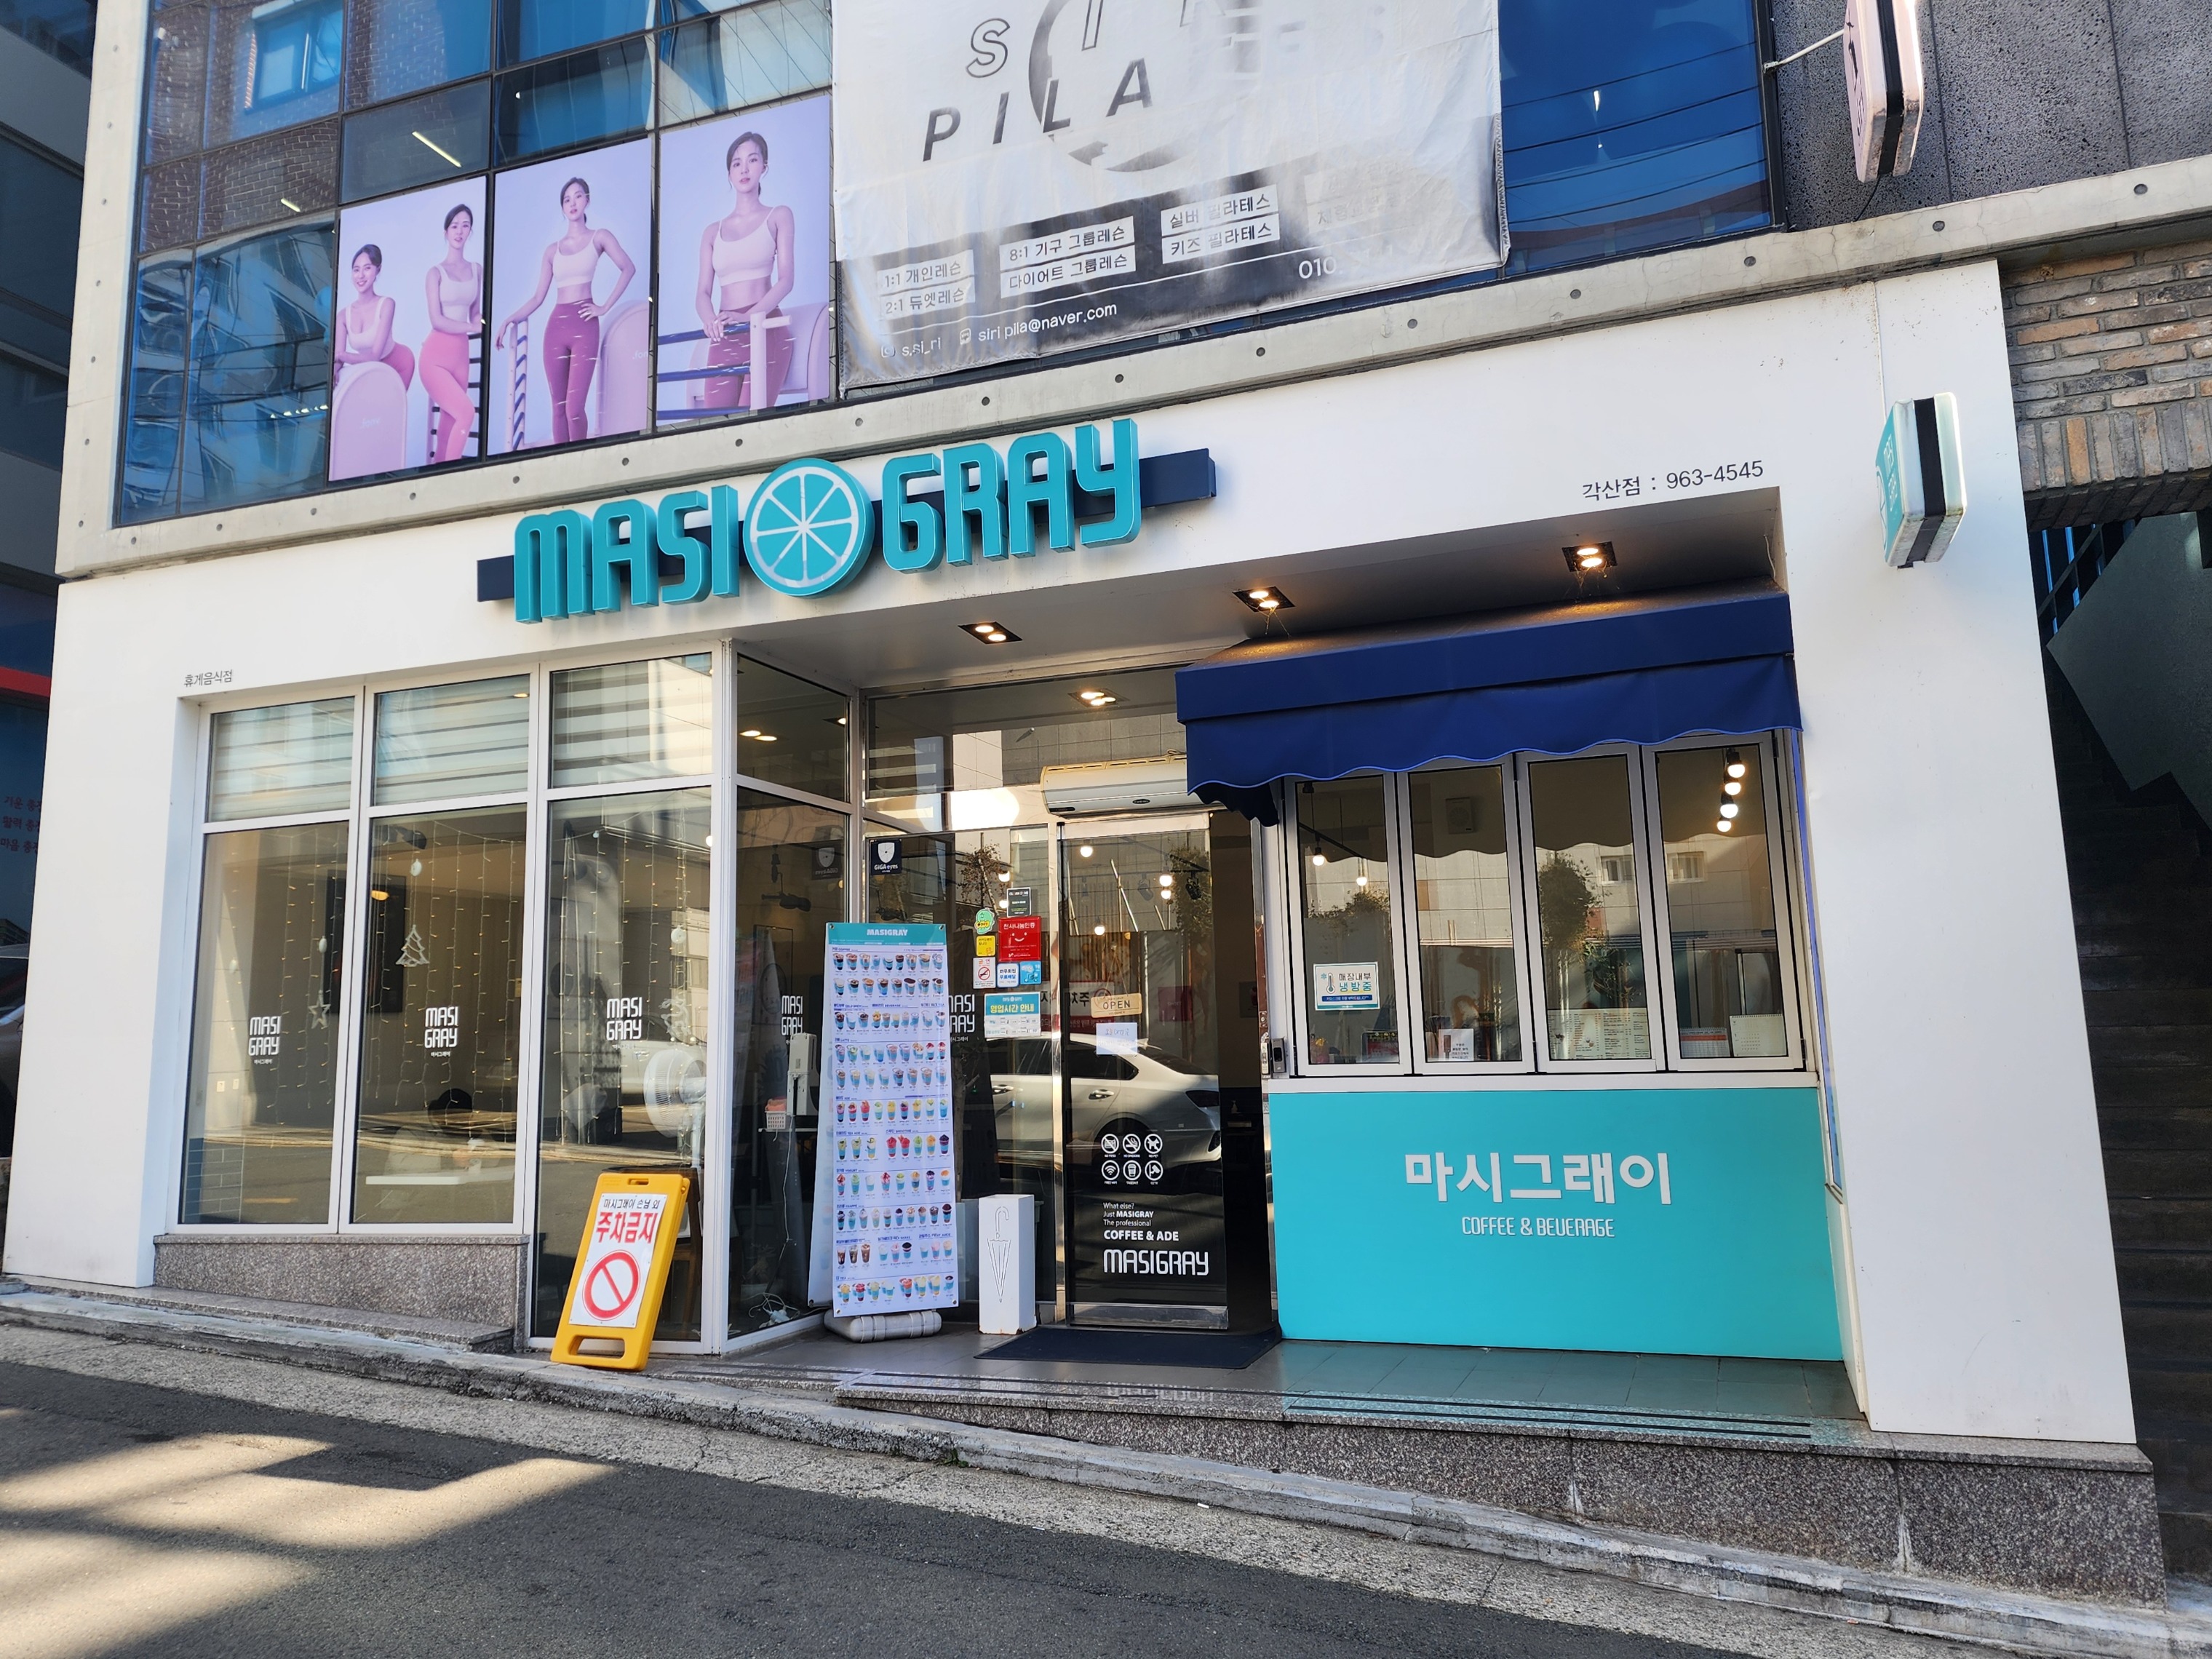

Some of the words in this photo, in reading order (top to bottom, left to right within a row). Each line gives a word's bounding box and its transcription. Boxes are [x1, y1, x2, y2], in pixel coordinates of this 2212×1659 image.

[1169, 210, 1200, 229] 실버
[1207, 193, 1271, 221] 필라테스
[1008, 246, 1030, 261] 8:1
[1035, 236, 1064, 257] 기구
[1067, 225, 1126, 251] 그룹레슨
[1170, 237, 1201, 256] 키즈
[1207, 222, 1272, 250] 필라테스
[884, 273, 902, 289] 1:1
[905, 260, 962, 283] 개인레슨
[1008, 266, 1065, 290] 다이어트
[1070, 252, 1128, 276] 그룹레슨
[885, 298, 904, 314] 2:1
[908, 286, 966, 310] 듀엣레슨
[1582, 476, 1641, 501] 각산점
[1666, 459, 1764, 490] 963-4545
[514, 485, 740, 624] MASI
[881, 416, 1140, 575] GRAY
[184, 669, 233, 688] 휴게음식점
[1338, 972, 1372, 981] 매장내부
[606, 997, 642, 1019] MASI
[781, 995, 803, 1014] MASI
[990, 1004, 1019, 1014] 영업시간
[1019, 1003, 1035, 1013] 안내
[1102, 998, 1131, 1010] OPEN
[249, 1016, 282, 1035] MASI
[425, 1006, 458, 1027] MASI
[781, 1017, 803, 1036] GRAY
[949, 1014, 975, 1033] RAY
[424, 1027, 458, 1049] GRAY
[606, 1019, 642, 1041] GRAY
[248, 1036, 280, 1057] GRAY
[1405, 1152, 1671, 1205] 마시그래이
[603, 1198, 636, 1209] 마시그래이
[637, 1199, 651, 1209] 손님
[652, 1199, 661, 1209] 외
[1102, 1210, 1115, 1218] Just
[1115, 1210, 1155, 1218] MASIGRAY
[596, 1211, 659, 1244] 주차금지
[1115, 1219, 1152, 1228] professional
[1461, 1216, 1516, 1236] COFFEE
[1520, 1217, 1533, 1236] &
[1537, 1218, 1616, 1238] BEVERAGE
[1103, 1230, 1144, 1241] COFFEE
[1145, 1230, 1155, 1241] &
[1156, 1230, 1179, 1241] ADE
[1103, 1249, 1209, 1276] MASIGRAY
